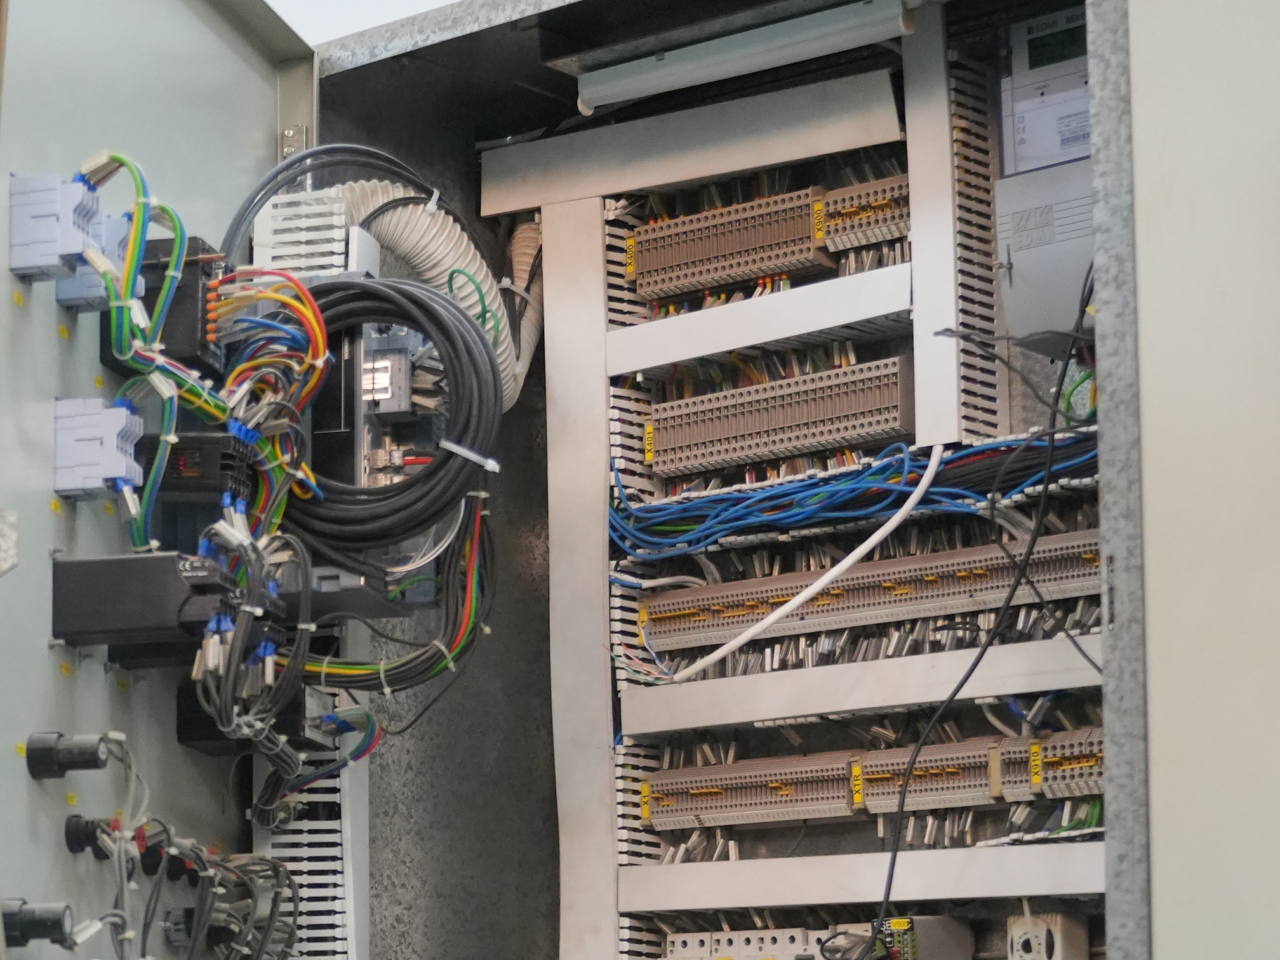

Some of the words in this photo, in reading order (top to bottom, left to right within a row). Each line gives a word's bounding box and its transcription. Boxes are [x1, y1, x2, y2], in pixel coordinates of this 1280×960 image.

[815, 208, 823, 234] X900
[646, 431, 654, 454] X401
[1031, 751, 1040, 777] X910
[853, 774, 861, 796] XTR
[642, 794, 650, 806] X1
